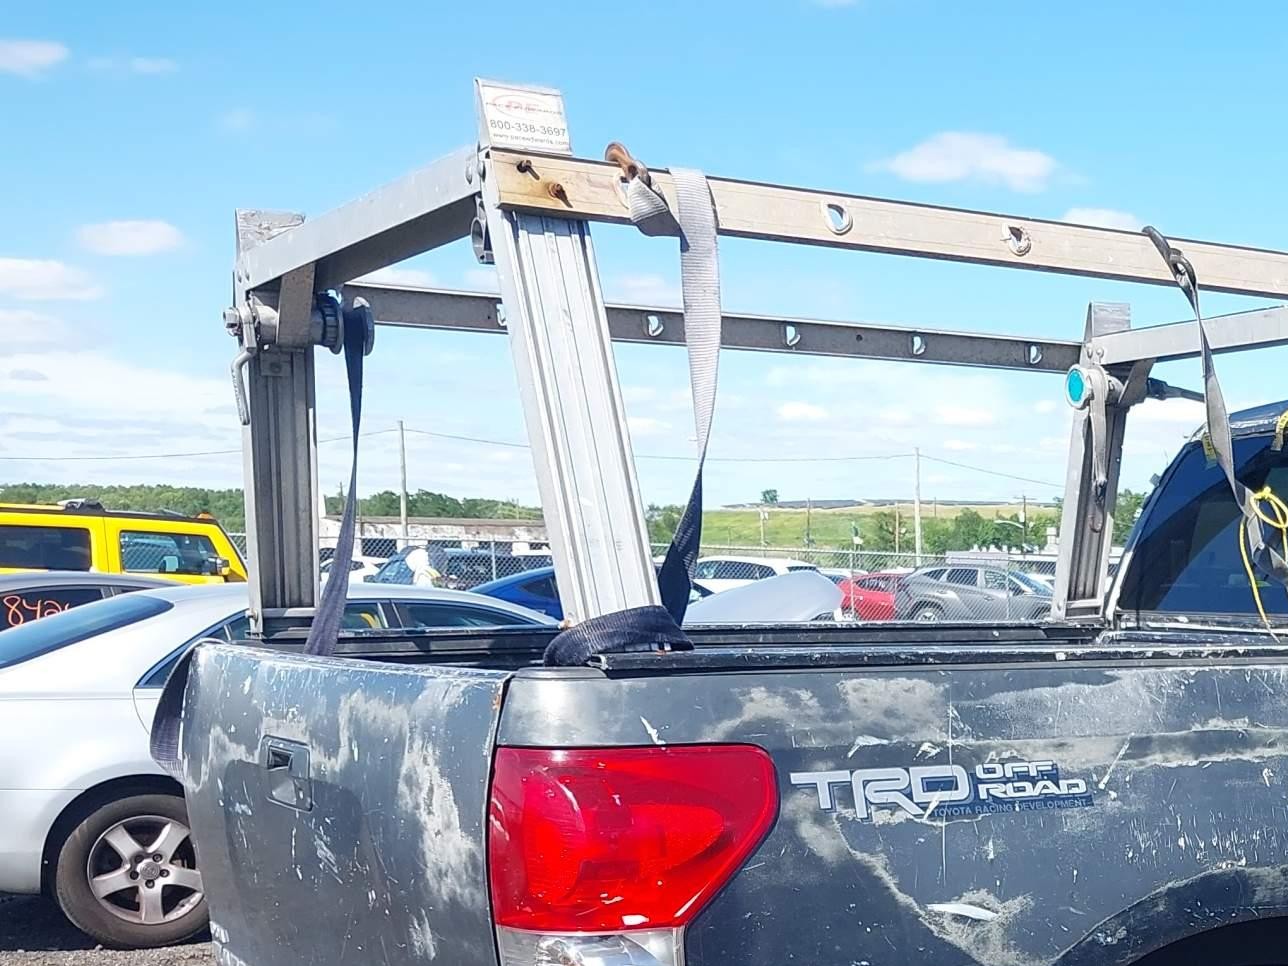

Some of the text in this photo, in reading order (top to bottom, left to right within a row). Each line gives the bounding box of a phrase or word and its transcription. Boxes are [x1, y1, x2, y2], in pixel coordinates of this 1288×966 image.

[490, 119, 566, 137] 800-338-3697
[975, 760, 1055, 779] OFF
[790, 764, 971, 820] TRD
[977, 778, 1088, 800] ROAD
[933, 799, 1089, 817] TOYOTA RACING DEVELOPMENT
